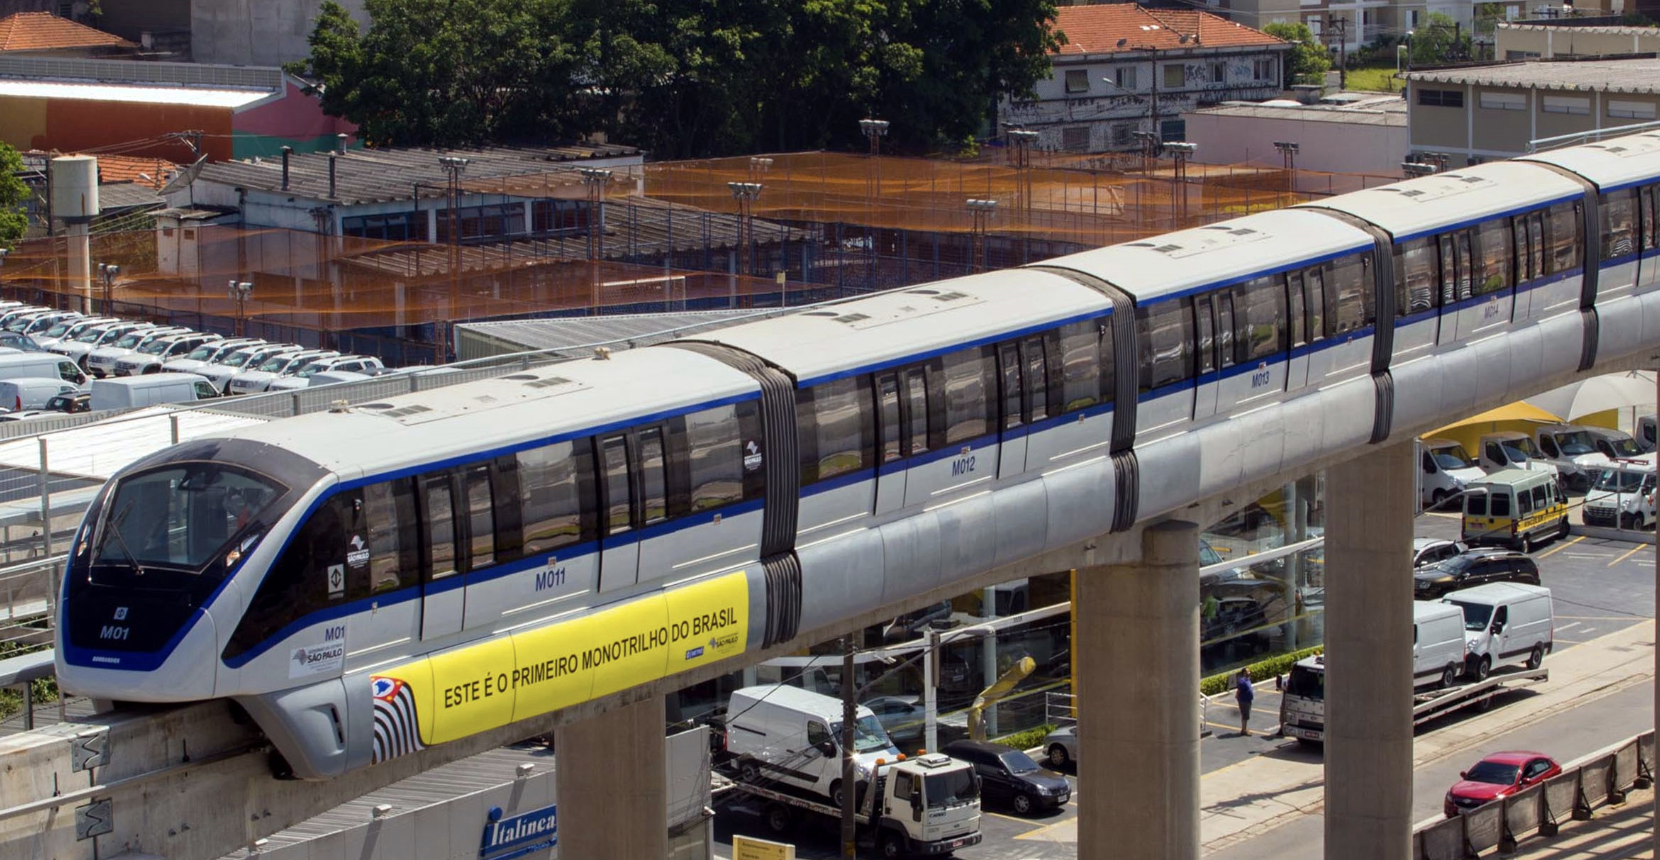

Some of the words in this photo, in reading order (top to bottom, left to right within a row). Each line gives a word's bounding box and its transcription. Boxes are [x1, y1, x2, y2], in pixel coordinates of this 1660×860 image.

[1484, 304, 1499, 319] M014
[1252, 370, 1270, 389] M013
[952, 455, 976, 477] M012
[535, 566, 566, 592] M011
[100, 626, 129, 640] M01
[325, 624, 346, 642] M01
[322, 648, 342, 660] PAULO
[444, 680, 480, 709] ESTE
[484, 671, 493, 698] É
[497, 673, 508, 693] O
[512, 654, 578, 689] PRIMEIRO
[581, 626, 668, 671] MONOTRILHO
[671, 620, 689, 642] DO
[693, 607, 738, 636] BRASIL
